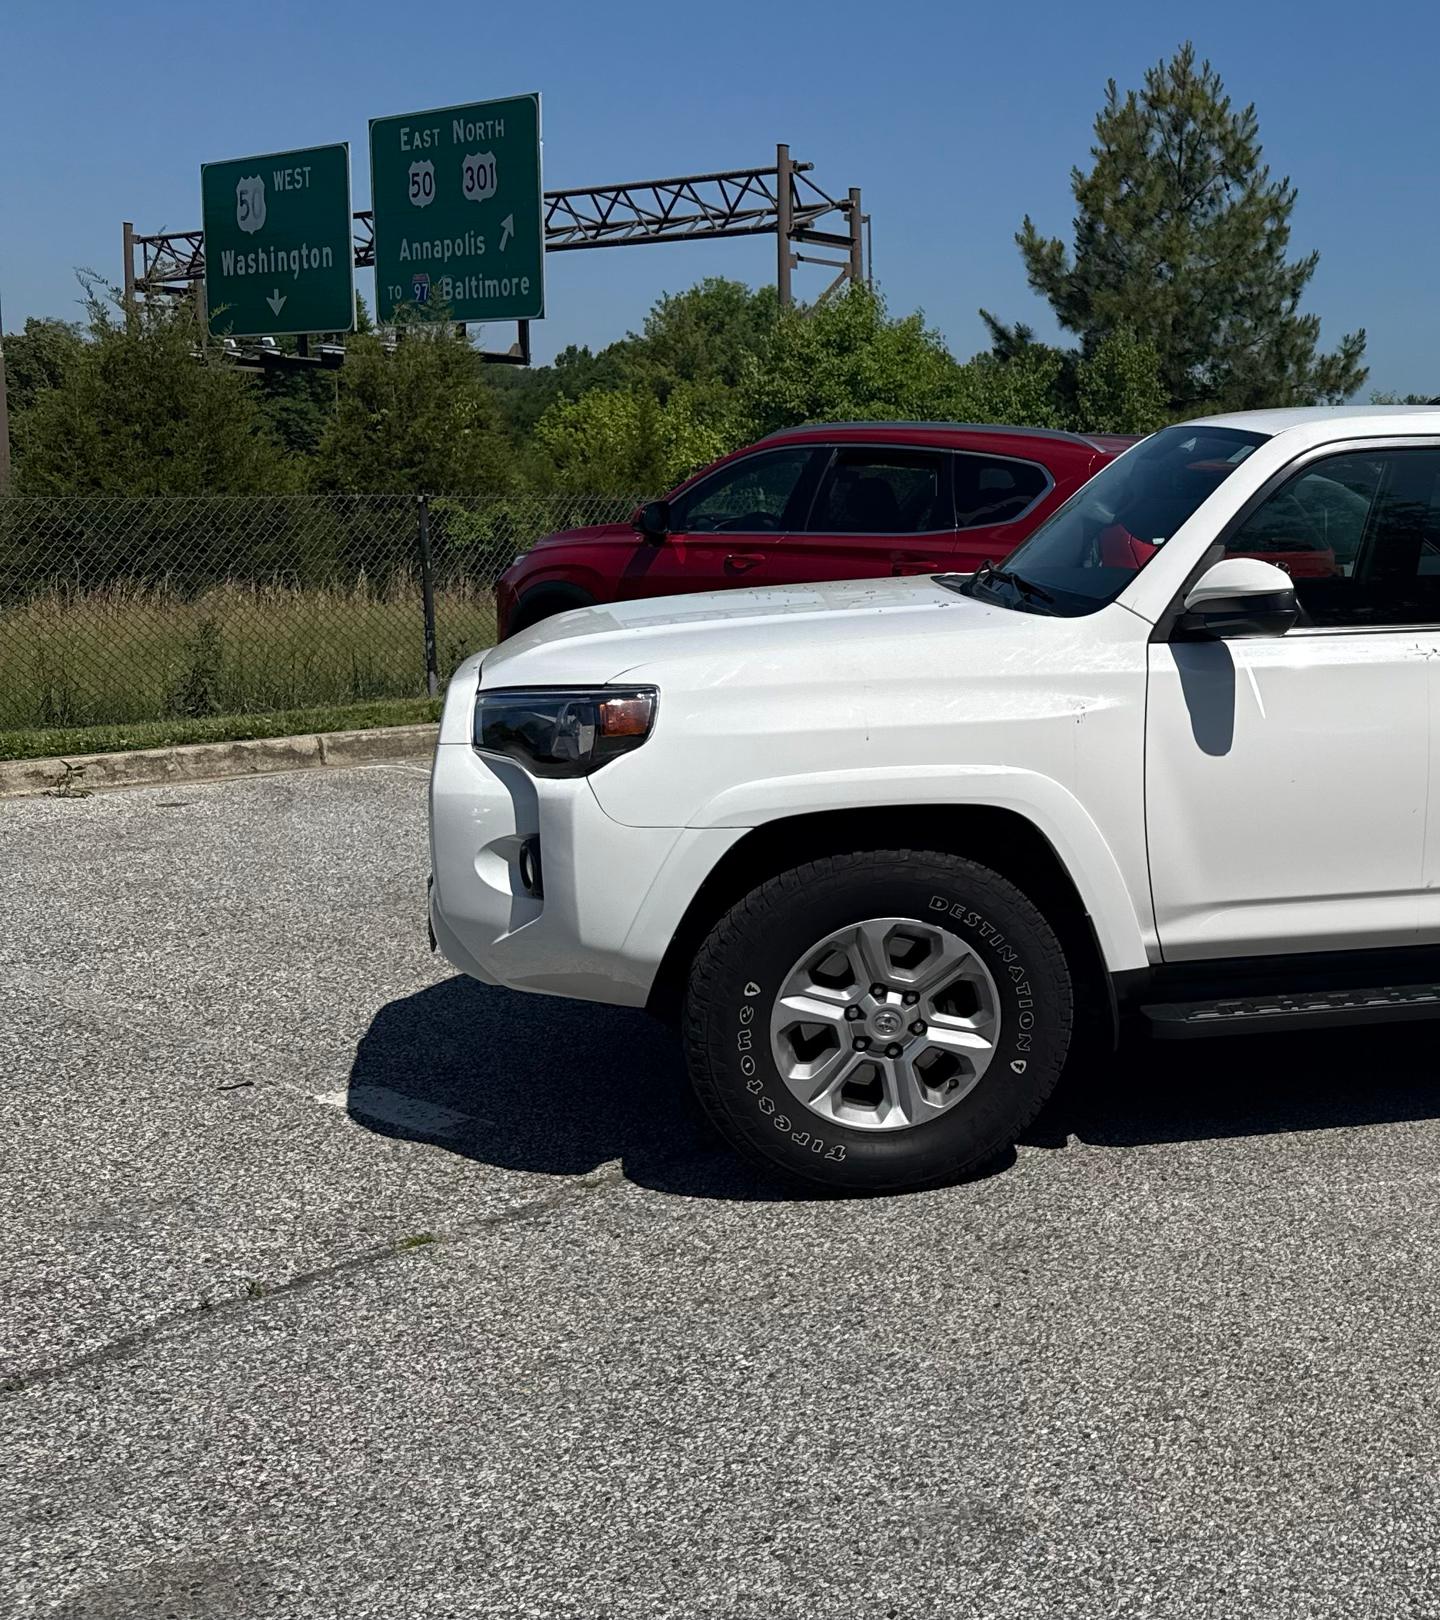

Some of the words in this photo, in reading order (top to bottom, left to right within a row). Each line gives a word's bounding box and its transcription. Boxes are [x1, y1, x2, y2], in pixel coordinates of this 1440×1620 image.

[400, 127, 440, 151] EAST
[452, 119, 505, 144] NORTH
[239, 188, 264, 221] 50
[273, 166, 311, 191] WEST
[411, 171, 433, 198] 50
[465, 162, 494, 192] 301
[221, 242, 333, 280] Washington
[400, 231, 486, 263] Annapolis
[388, 285, 402, 300] TO
[414, 283, 429, 301] 97
[443, 273, 530, 300] Baltimore
[929, 896, 1034, 1052] DESTINATION
[737, 1005, 848, 1162] Firestone
